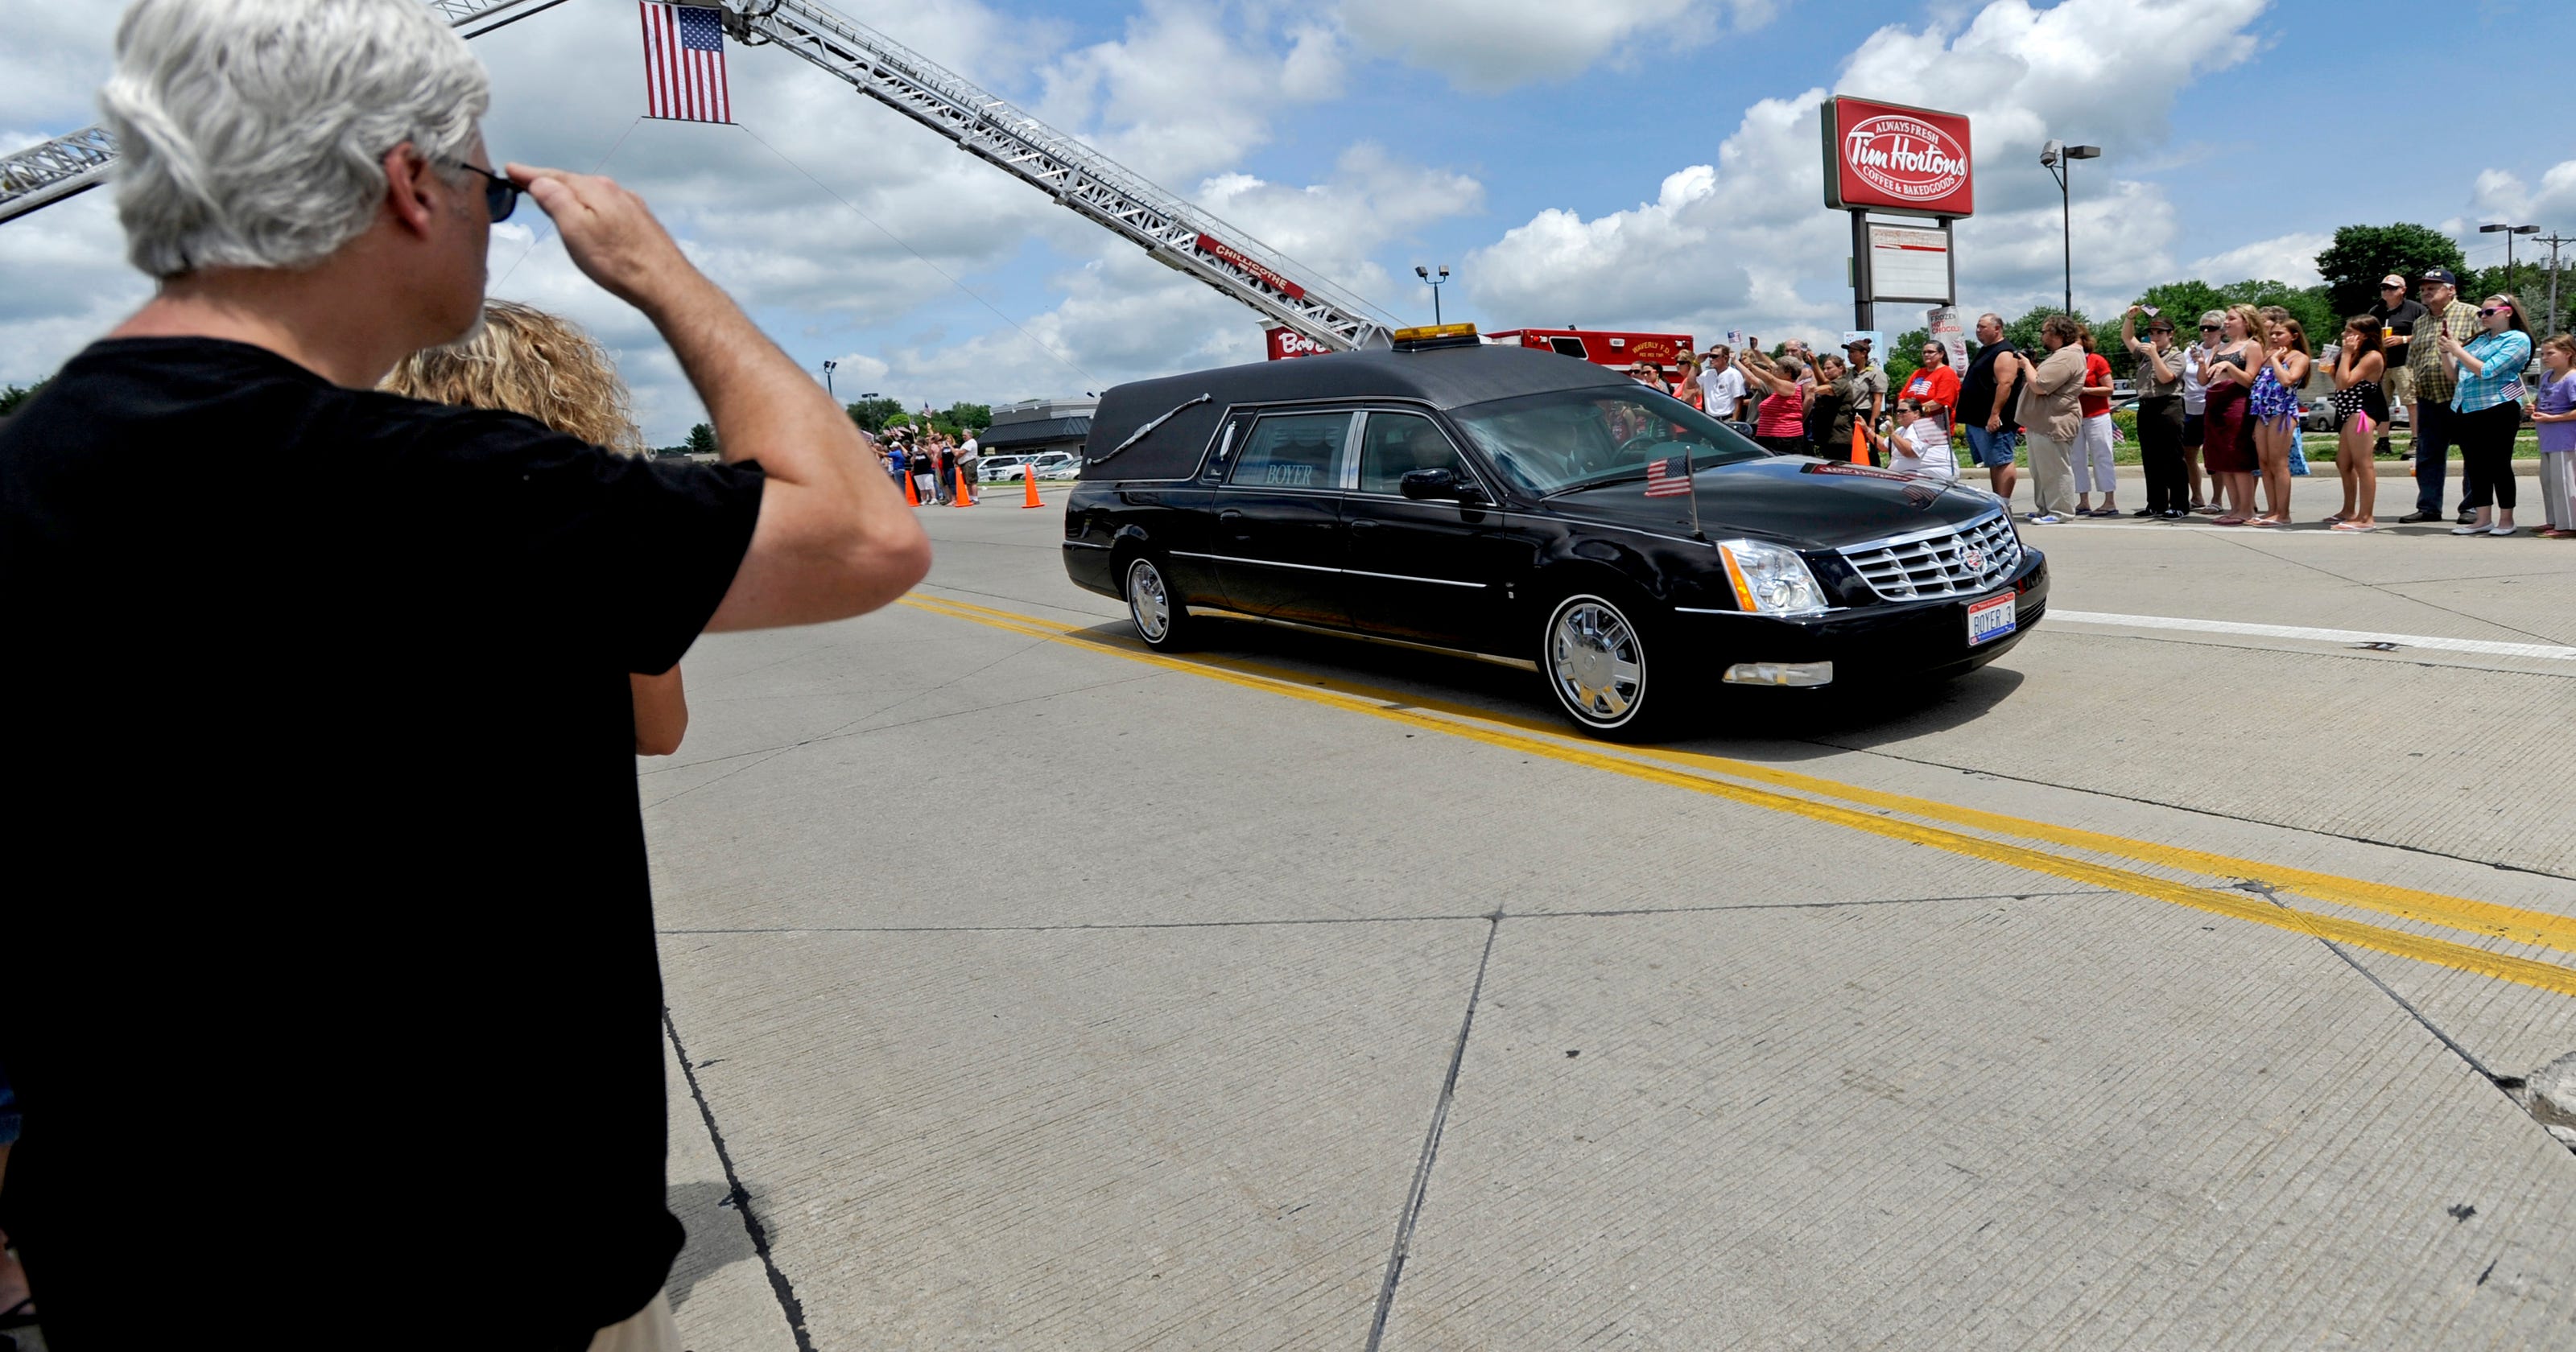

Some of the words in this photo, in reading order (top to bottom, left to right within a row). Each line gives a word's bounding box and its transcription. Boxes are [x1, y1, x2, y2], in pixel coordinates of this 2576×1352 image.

[1876, 122, 1909, 134] ALWAYS
[1910, 124, 1939, 144] FRESH
[1848, 131, 1888, 169] Tim
[1890, 134, 1965, 176] Hortons
[1863, 166, 1893, 190] COFFEE
[1895, 183, 1901, 192] &
[1216, 245, 1287, 290] CHILLICOTHE
[1632, 341, 1658, 353] WAVERLY
[1266, 464, 1312, 485] BOYER
[1974, 609, 2001, 635] BOYER
[2006, 605, 2012, 624] 3
